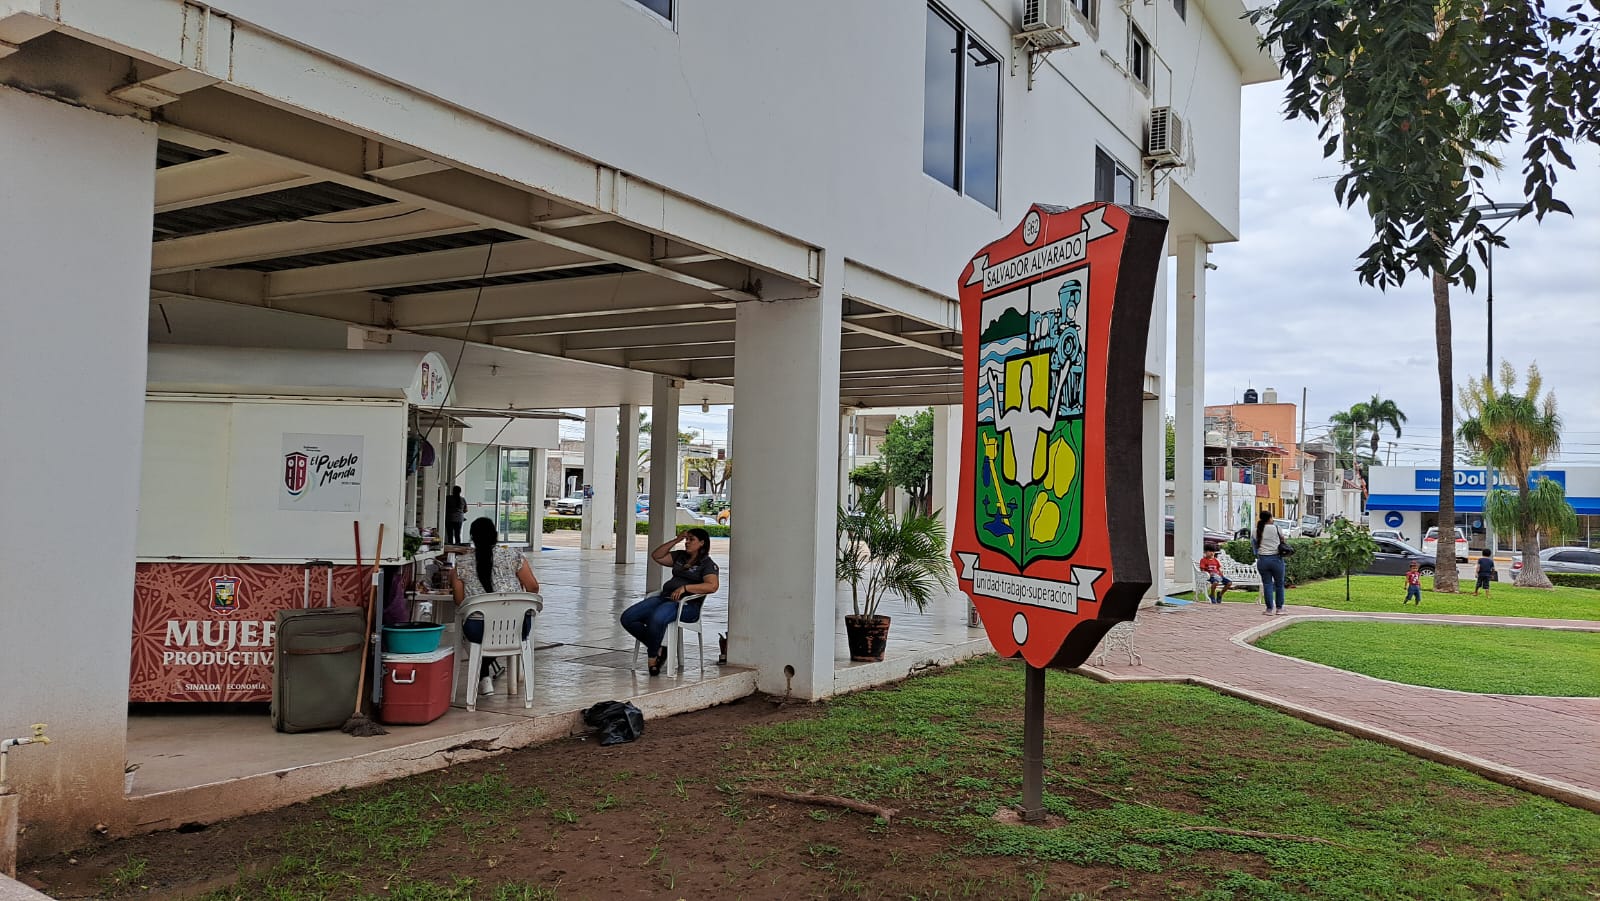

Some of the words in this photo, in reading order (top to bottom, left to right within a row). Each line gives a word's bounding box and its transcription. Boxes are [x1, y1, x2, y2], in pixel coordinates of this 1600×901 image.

[1025, 218, 1038, 238] 1962
[986, 257, 1028, 287] SALVADOR
[1031, 237, 1082, 273] ALVARADO
[310, 455, 319, 466] El
[316, 453, 358, 473] Pueblo
[320, 467, 356, 487] Manda
[163, 651, 274, 666] PRODUCTIV
[185, 683, 220, 691] SINALOA
[226, 682, 266, 690] ECONOMÍA
